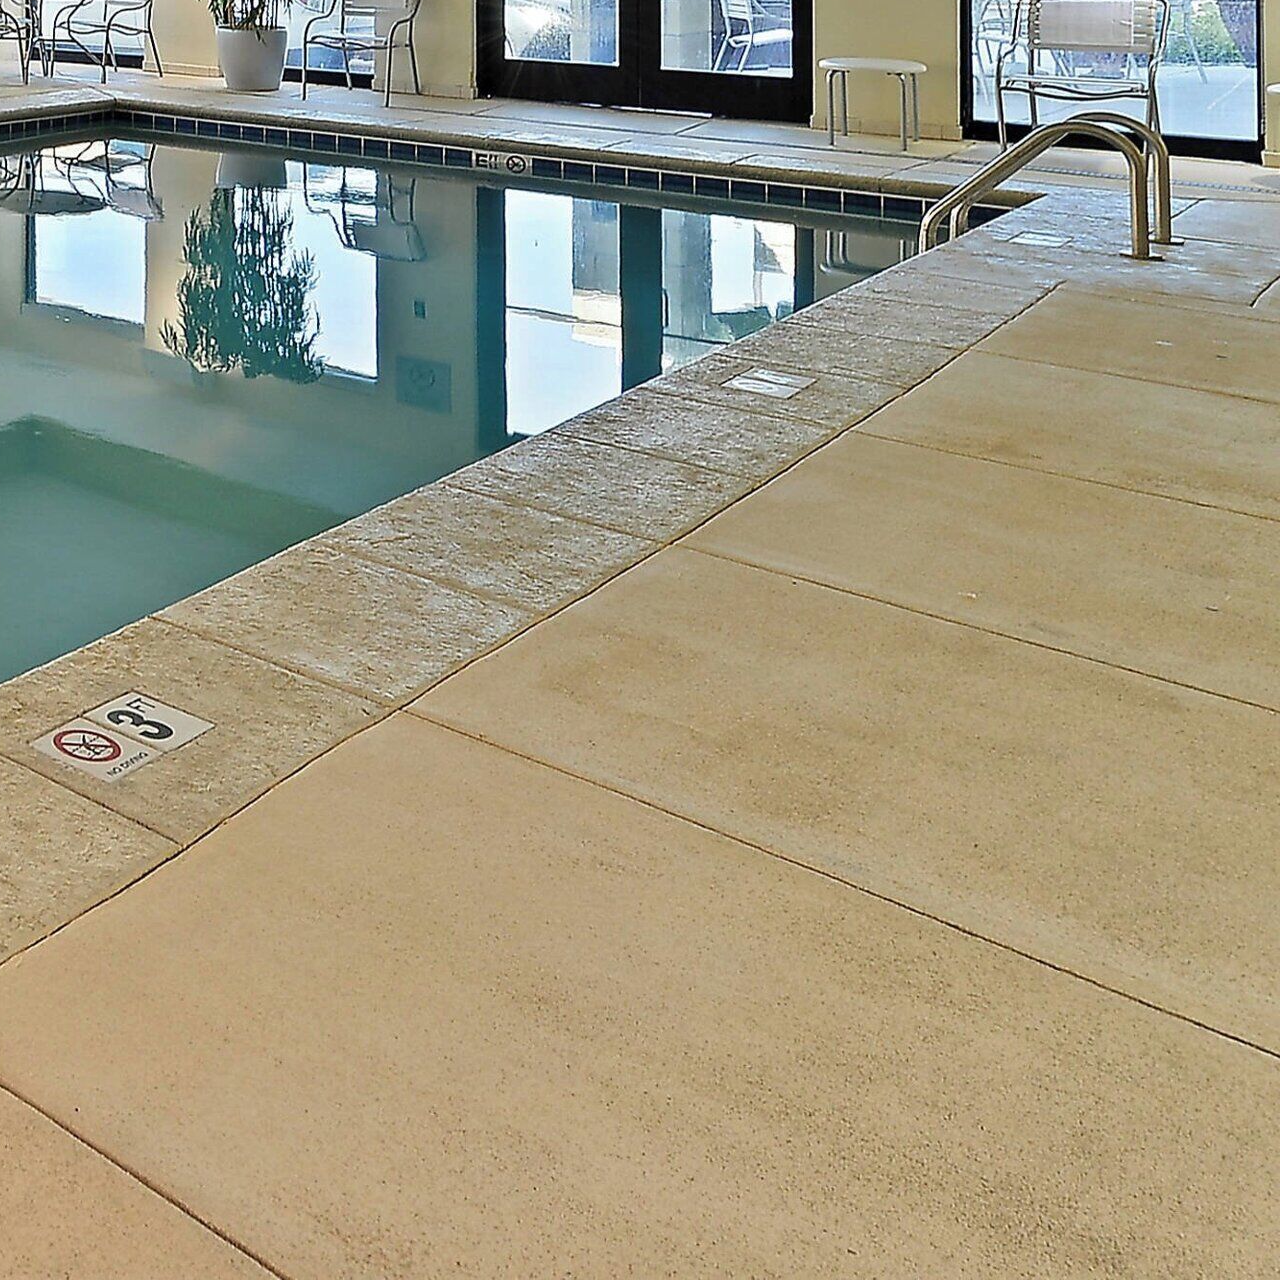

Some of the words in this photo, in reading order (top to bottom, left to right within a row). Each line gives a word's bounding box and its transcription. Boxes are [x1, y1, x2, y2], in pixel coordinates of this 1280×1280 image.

[126, 697, 156, 713] FT
[106, 709, 174, 740] 3
[106, 766, 122, 776] NO
